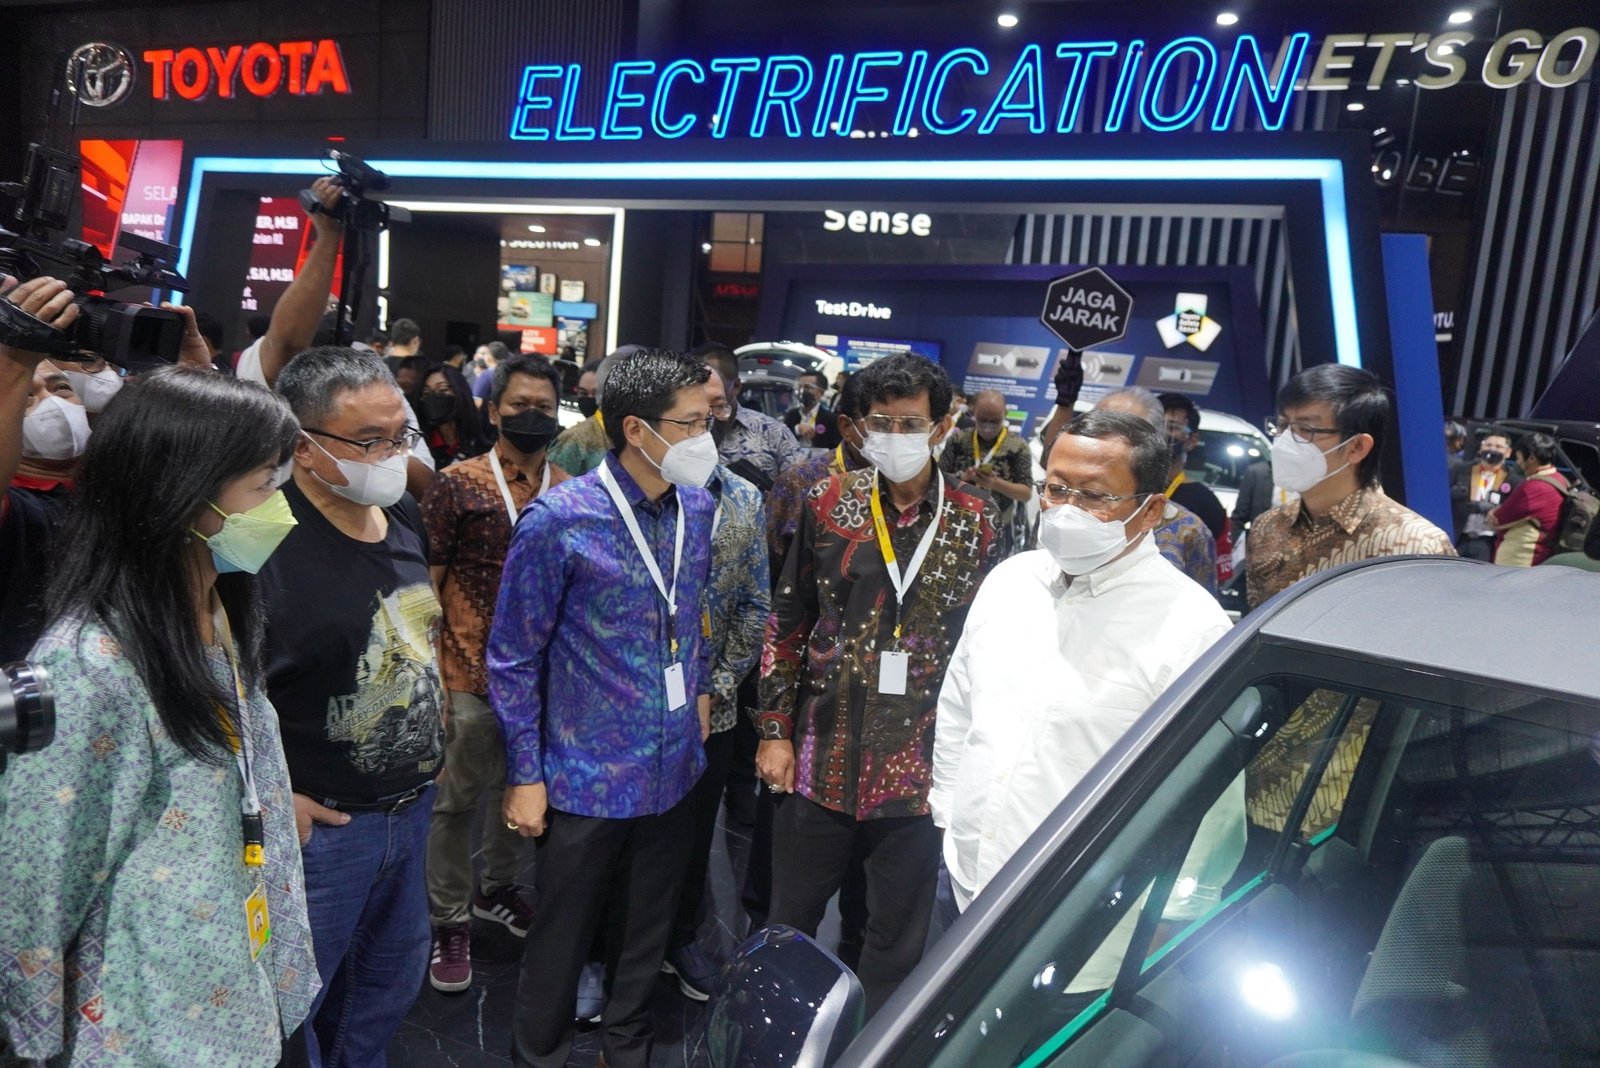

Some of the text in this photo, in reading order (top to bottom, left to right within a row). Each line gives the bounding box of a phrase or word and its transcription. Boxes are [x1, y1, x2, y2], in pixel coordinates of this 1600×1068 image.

[144, 39, 351, 100] TOYOTA
[1482, 27, 1600, 88] GO
[510, 33, 1310, 140] ELECTRIFICATION
[823, 209, 932, 236] Sense
[815, 299, 892, 320] Test Drive
[1061, 287, 1116, 312] JAGA
[1049, 304, 1120, 333] JARAK
